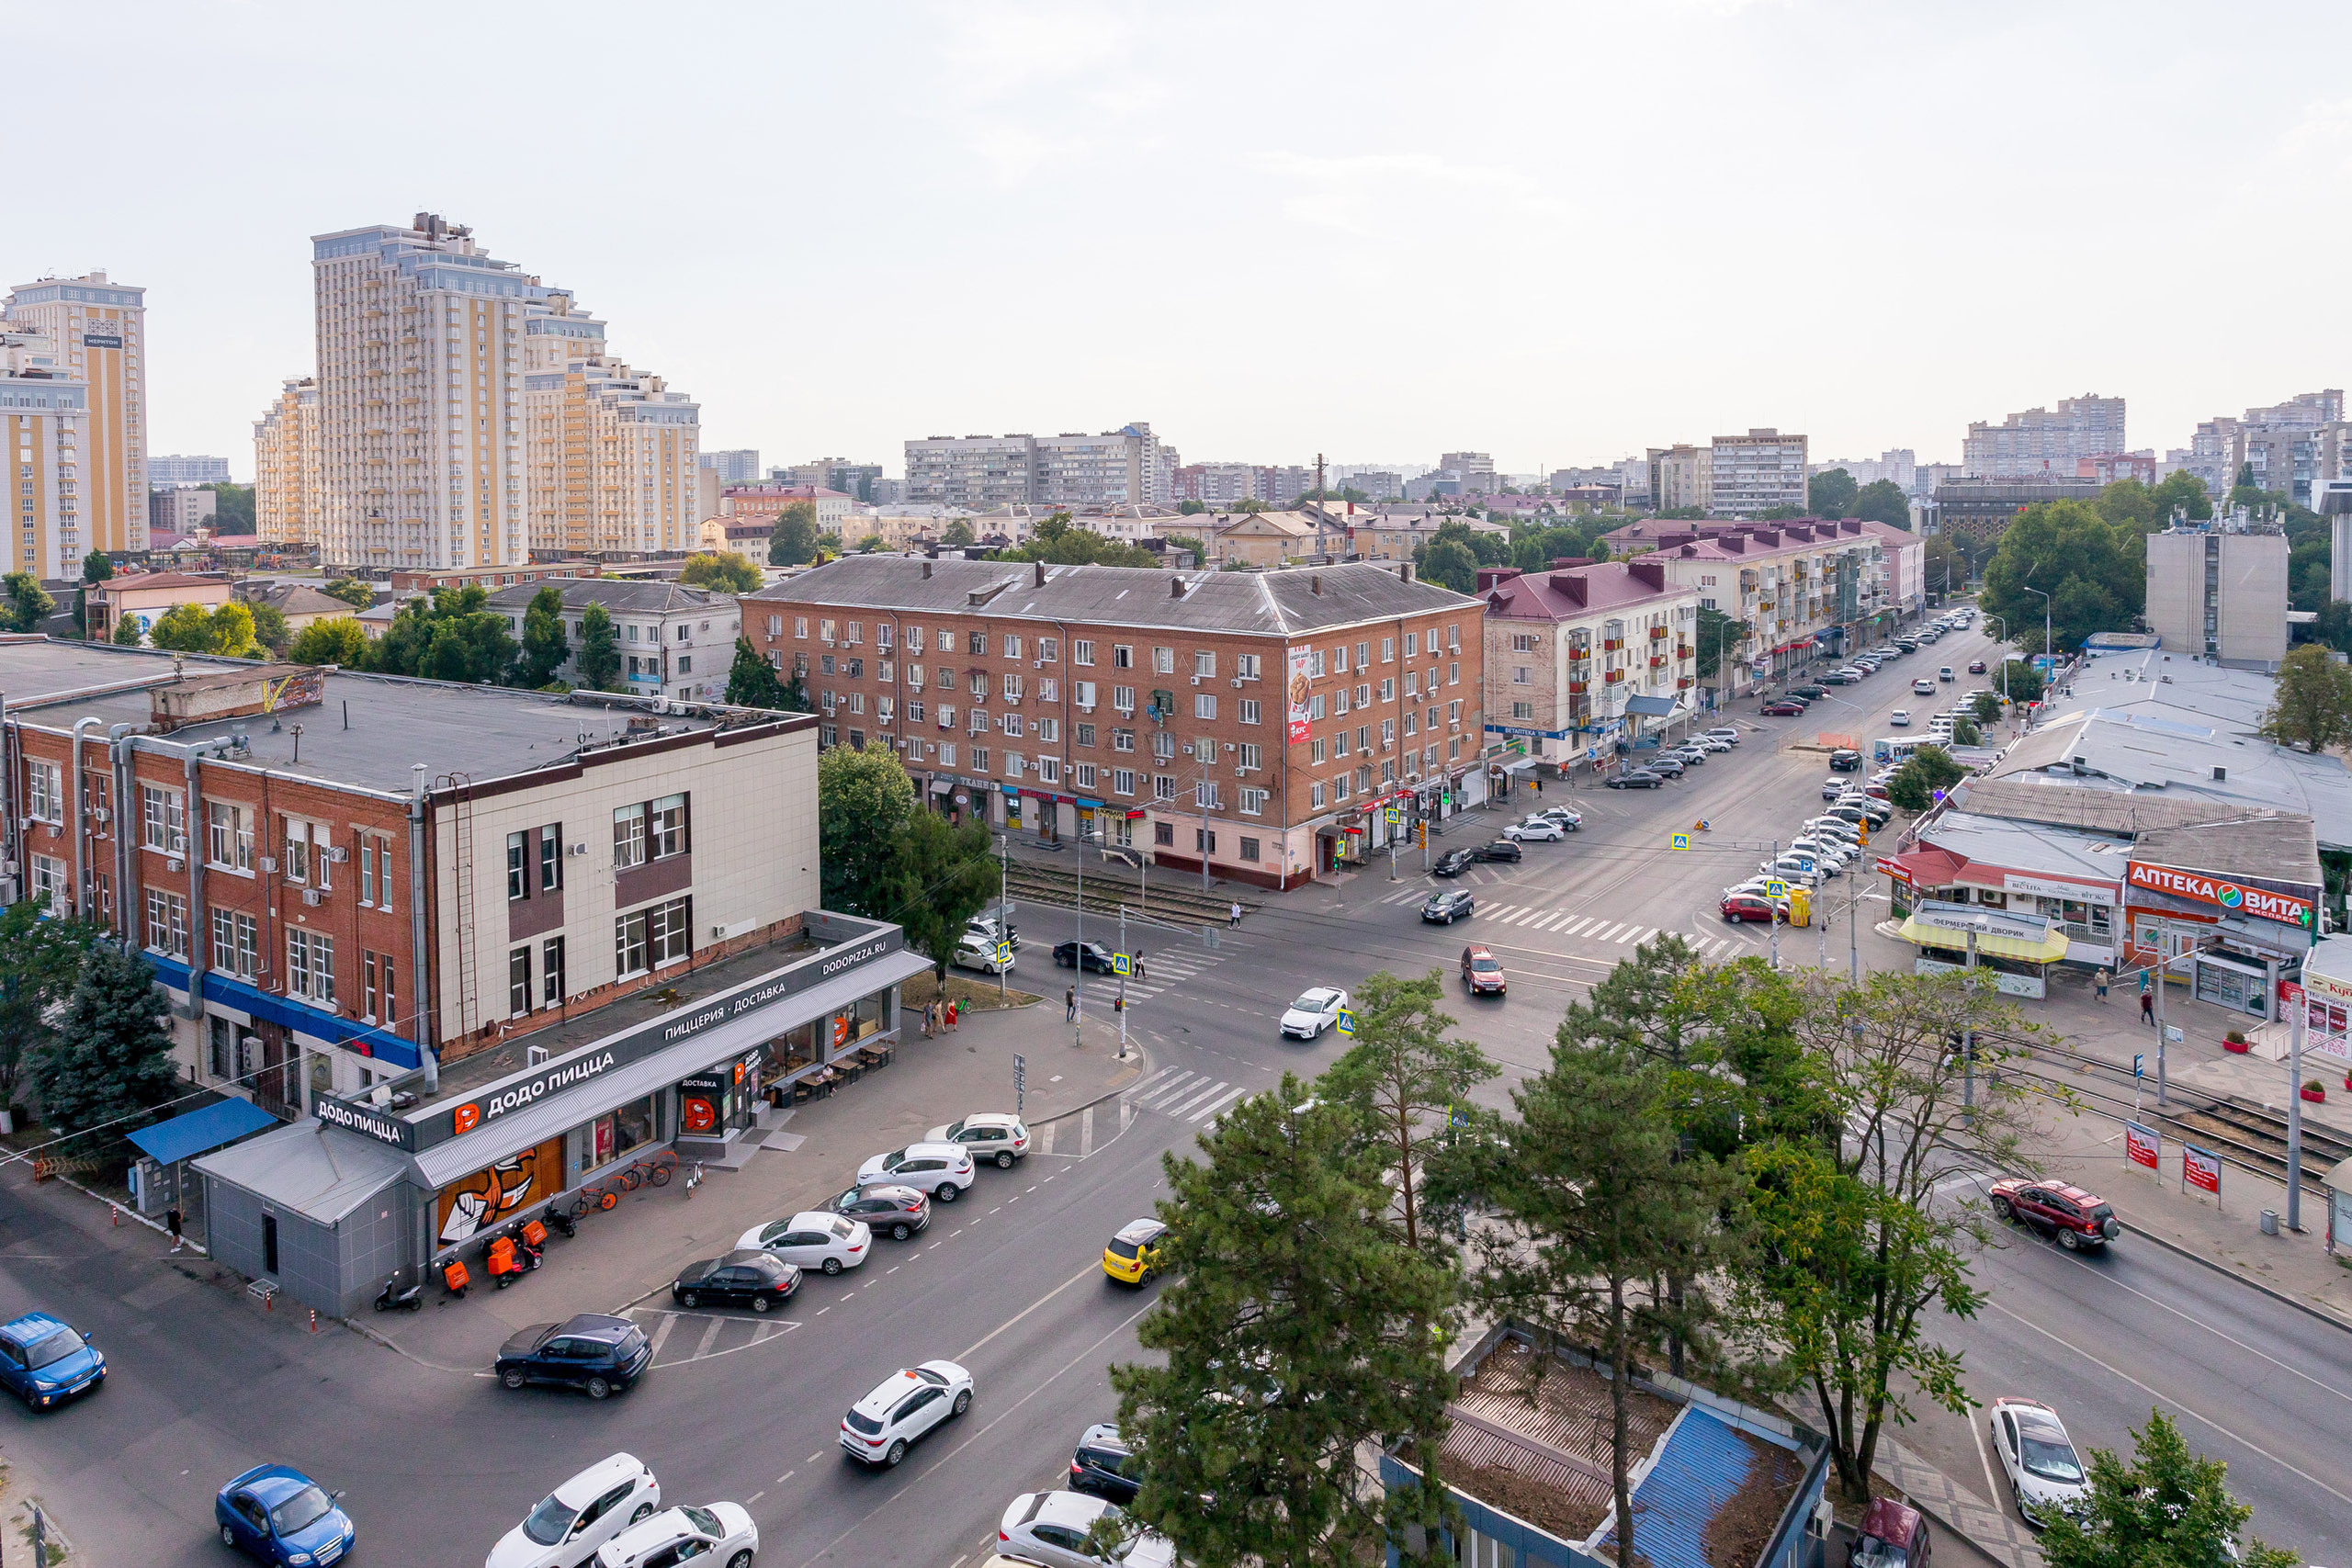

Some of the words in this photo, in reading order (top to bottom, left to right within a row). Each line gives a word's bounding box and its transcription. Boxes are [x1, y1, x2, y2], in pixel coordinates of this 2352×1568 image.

[1295, 726, 1306, 735] KFC
[1505, 728, 1536, 737] ВЕТАПТЕКА
[2132, 865, 2215, 898] АПТЕКА
[2245, 892, 2301, 917] ВИТА
[1933, 918, 1987, 931] ФЕРМЕРИЙ
[1990, 926, 2025, 938] ДВОРИК
[822, 942, 887, 975] DODOPIZZA.RU
[664, 1007, 724, 1041] ПИЦЦЕРИЯ
[733, 982, 786, 1014] ДОСТАВКА
[2330, 1018, 2346, 1027] SALE
[745, 1049, 758, 1066] ДОДО
[745, 1056, 761, 1074] ПИЦЦА
[488, 1080, 545, 1118] ДОДО
[548, 1052, 615, 1091] ПИЦЦА
[682, 1079, 717, 1089] ДОСТАВКА
[319, 1100, 353, 1125] ДОДО
[354, 1113, 401, 1143] ПИЦЦА
